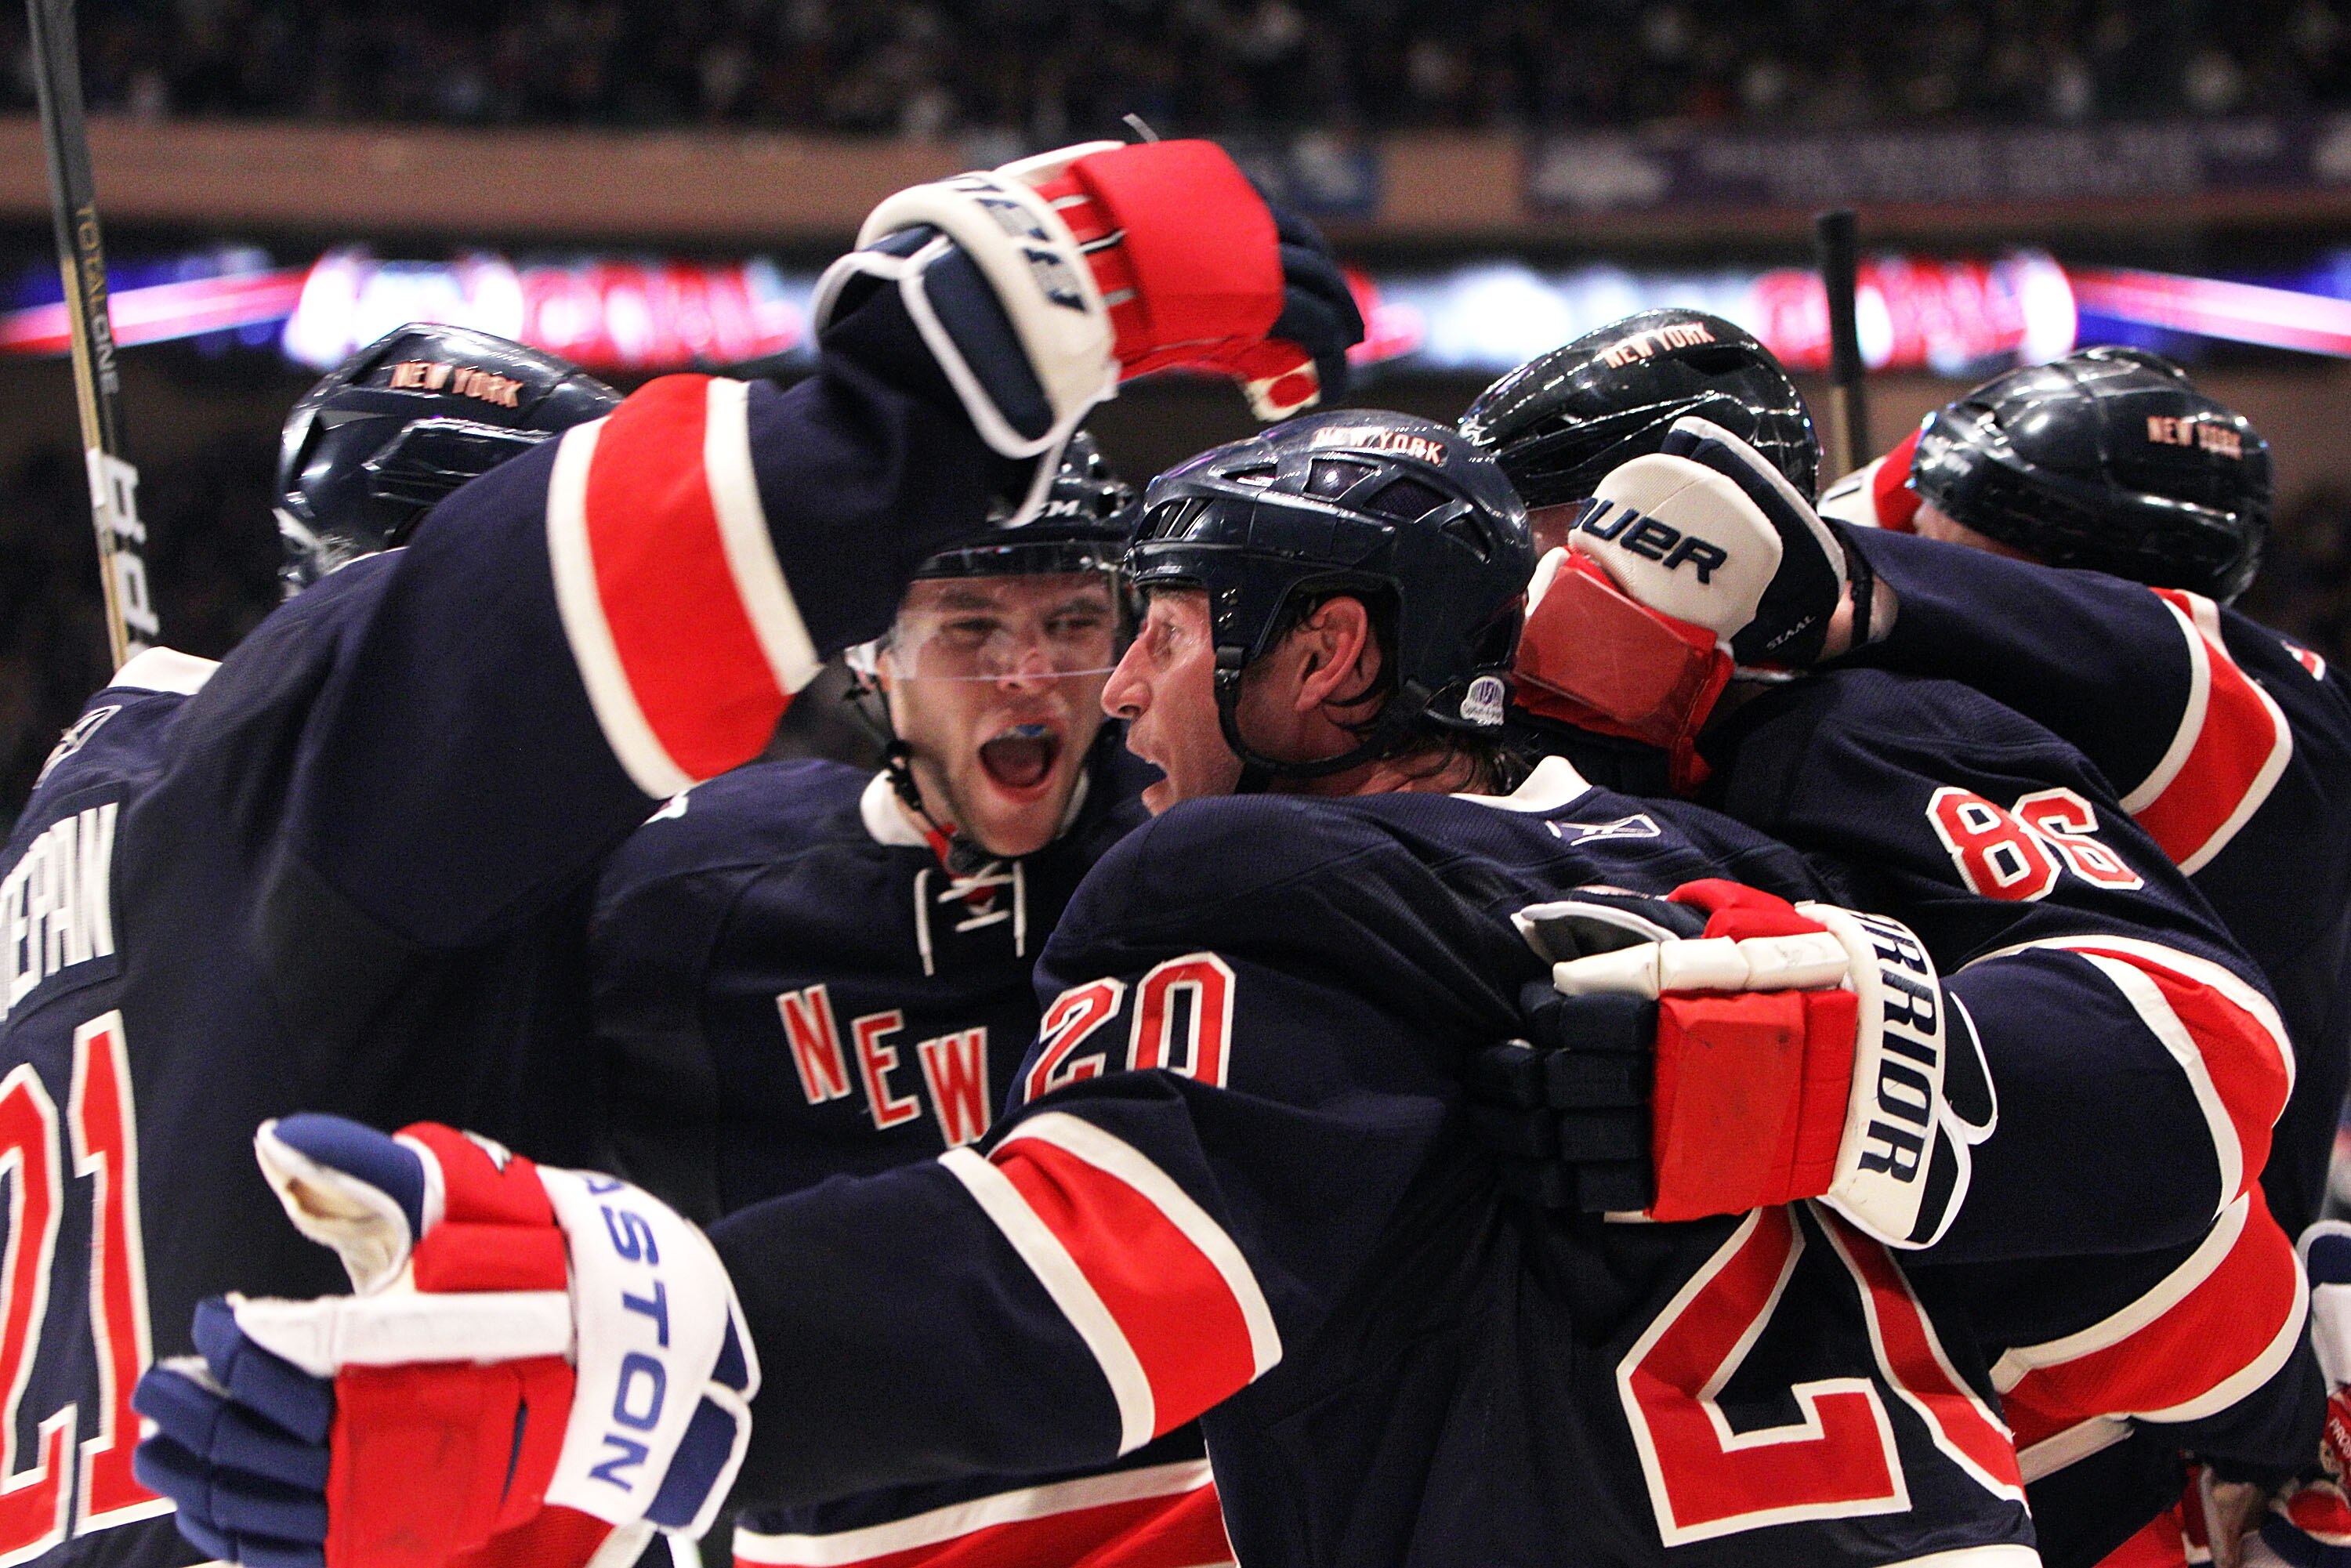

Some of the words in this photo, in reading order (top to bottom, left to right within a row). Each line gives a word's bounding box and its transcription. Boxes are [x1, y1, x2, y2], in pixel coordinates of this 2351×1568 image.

[389, 361, 453, 390] NEW
[451, 367, 523, 407] YORK
[1605, 329, 1654, 369] NEW
[1655, 322, 1716, 351] YORK
[1309, 426, 1385, 449] NEW
[1378, 431, 1444, 465] YORK
[2147, 415, 2193, 447] NEW
[1925, 786, 2144, 902] 86
[776, 983, 992, 1150] NEW
[1023, 951, 1236, 1105] 20
[0, 1009, 177, 1567] 21
